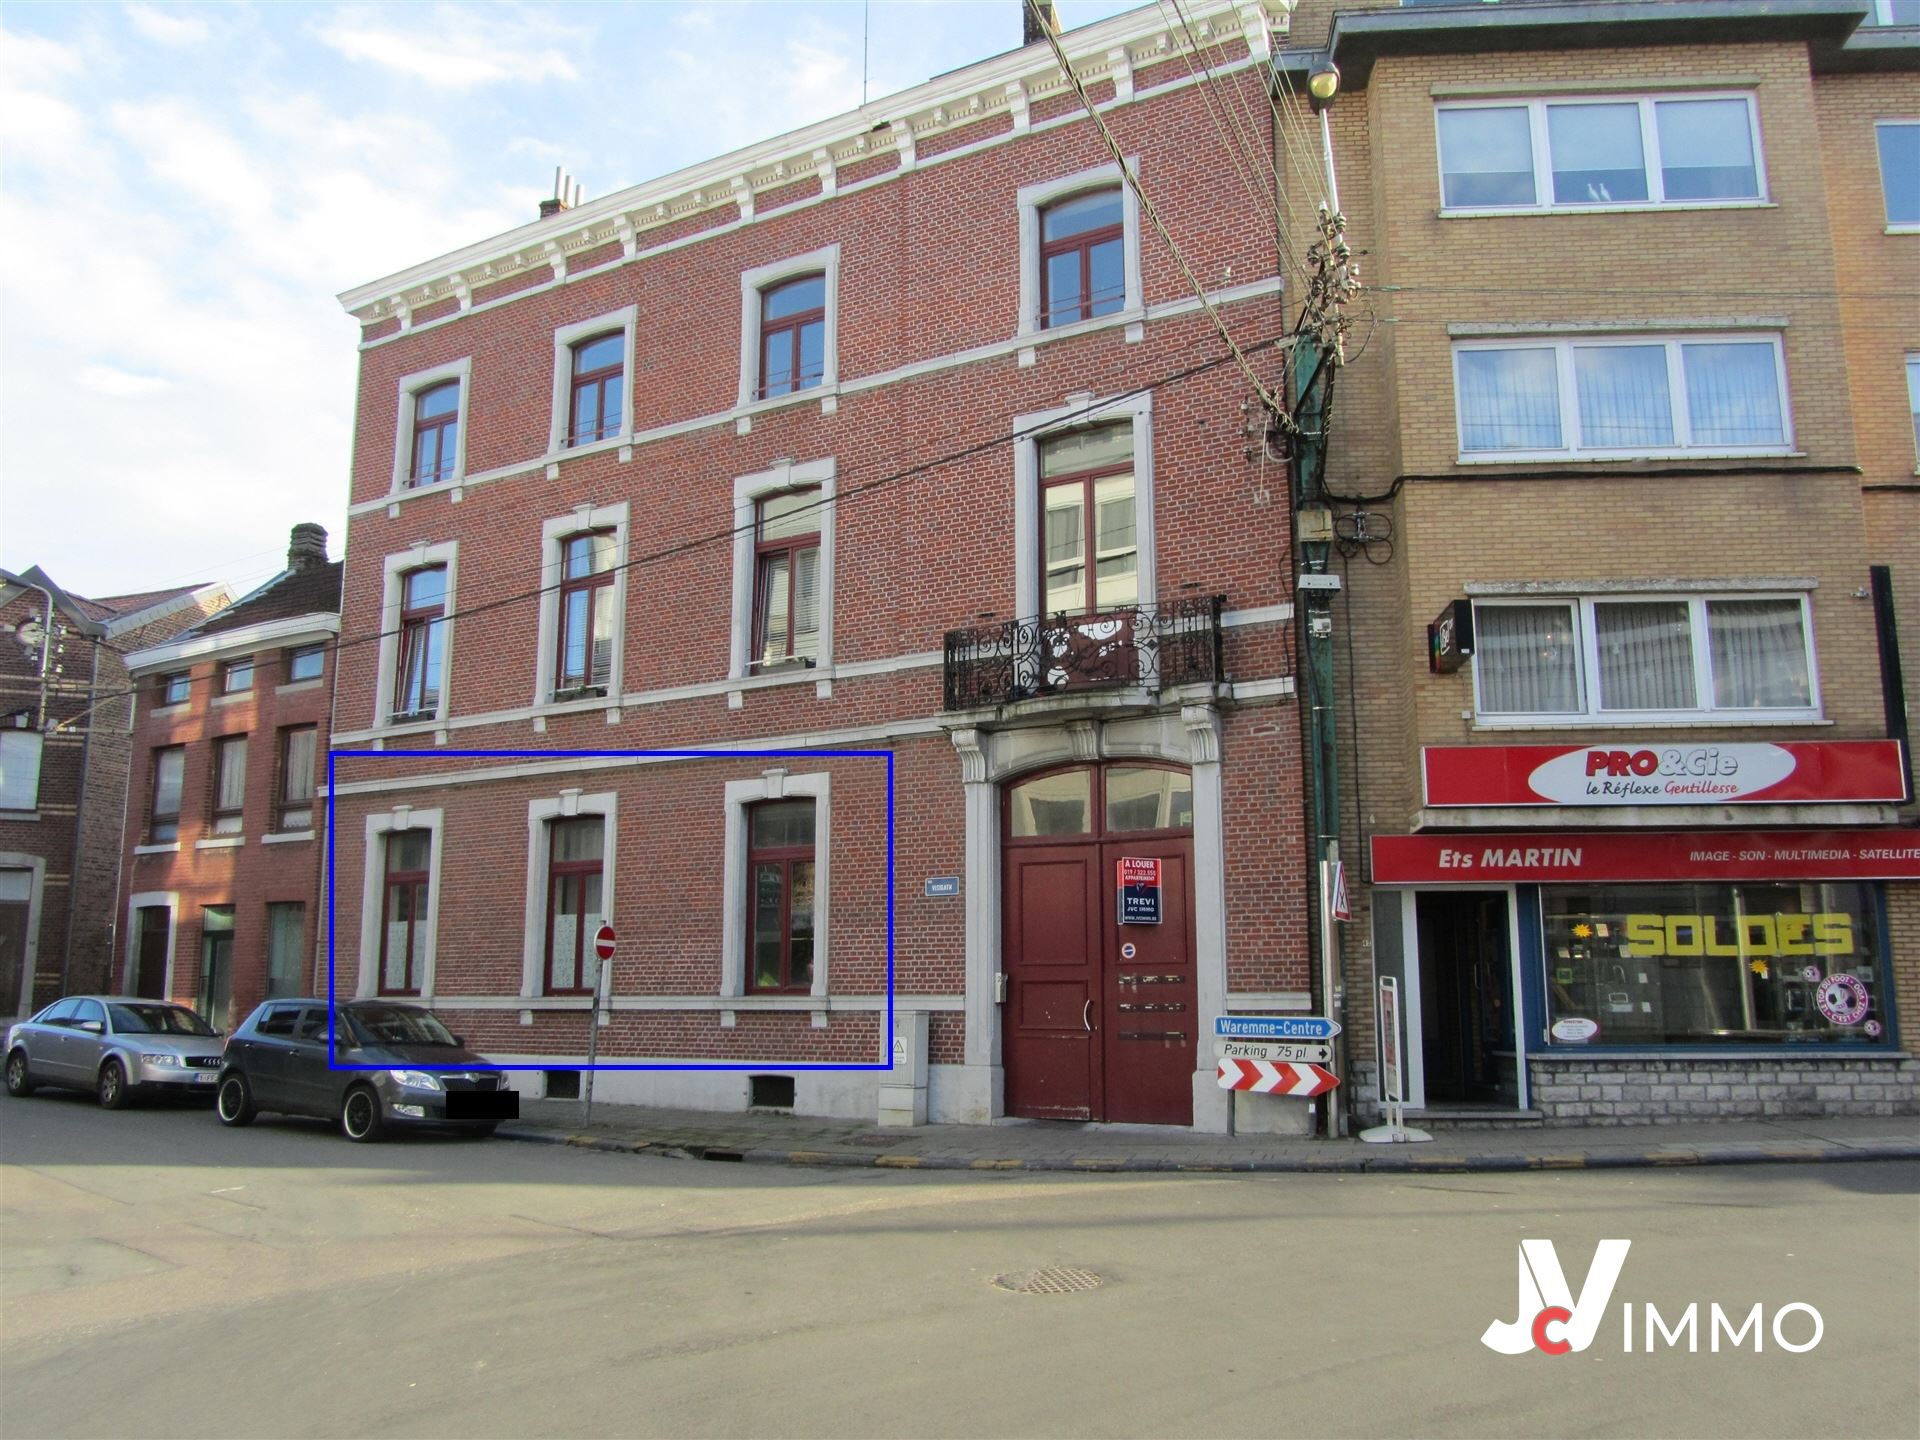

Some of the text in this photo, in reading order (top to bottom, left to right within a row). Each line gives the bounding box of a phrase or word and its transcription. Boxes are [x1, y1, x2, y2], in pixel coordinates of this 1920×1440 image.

[1586, 748, 1738, 776] PRO&Cie
[1586, 780, 1739, 798] le Réflexe Gentillesse
[1439, 848, 1582, 868] Ets MARTIN
[1690, 851, 1730, 861] IMAGE
[1739, 851, 1766, 861] SON
[1774, 850, 1850, 860] MULTIMEDIA
[1859, 849, 1920, 860] SATELLITE
[1125, 860, 1155, 869] A LOUER
[1627, 914, 1853, 956] SOLDES
[1220, 1019, 1322, 1035] Waremme-Centre
[1224, 1044, 1267, 1059] Parking
[1277, 1046, 1292, 1057] 75
